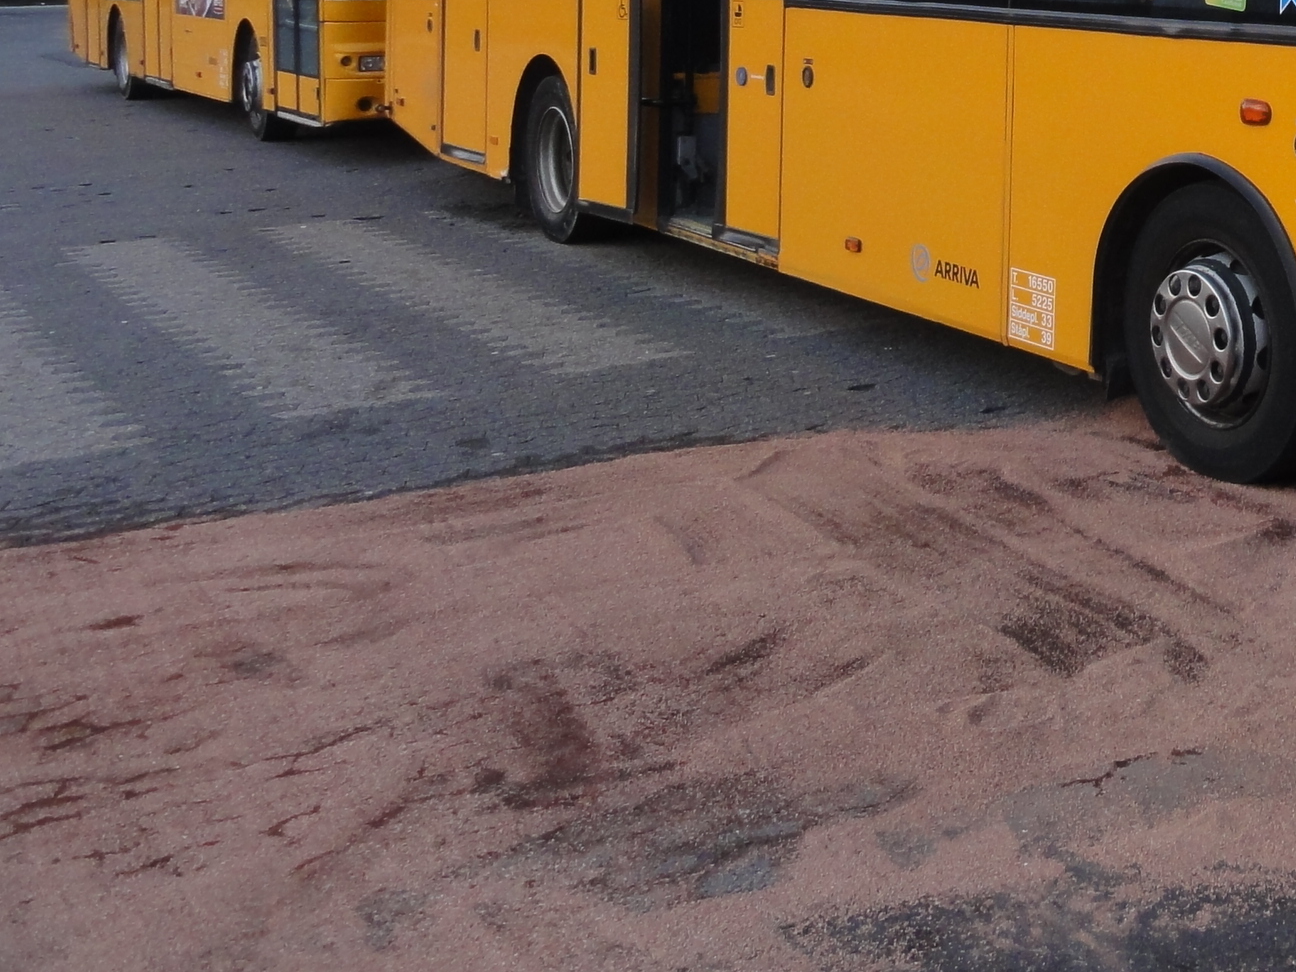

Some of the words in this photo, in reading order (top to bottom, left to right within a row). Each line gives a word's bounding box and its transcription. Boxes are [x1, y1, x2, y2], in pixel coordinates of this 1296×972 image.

[934, 259, 980, 290] ARRIVA
[1028, 275, 1054, 293] 16550
[1031, 293, 1053, 311] 5225
[1041, 313, 1053, 328] 33
[1041, 330, 1053, 346] 39
